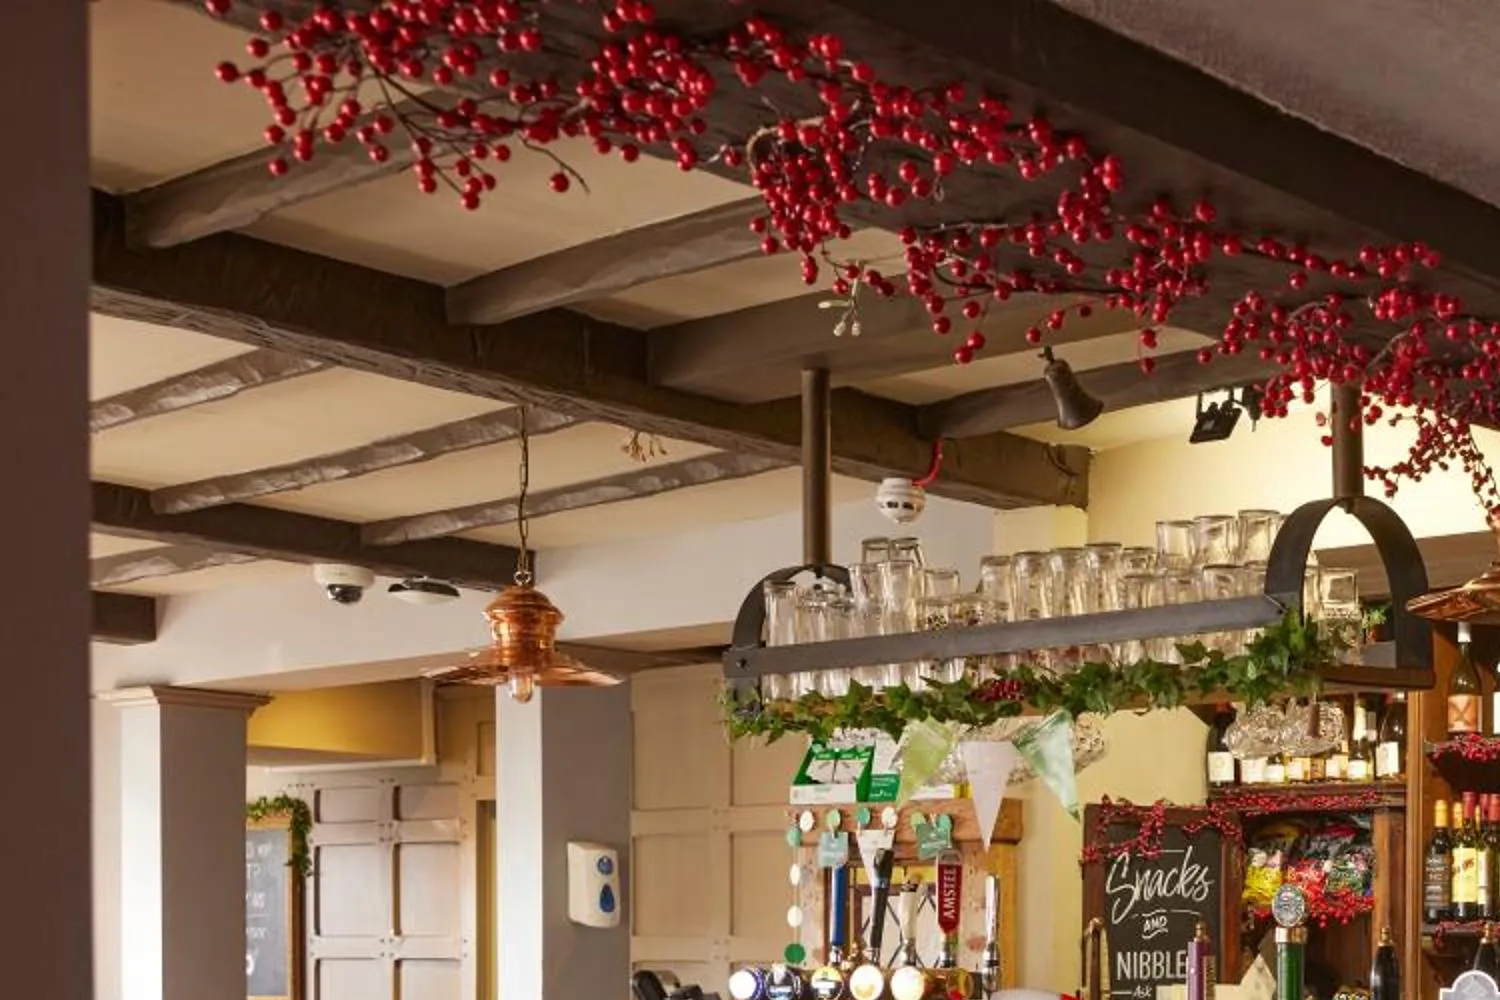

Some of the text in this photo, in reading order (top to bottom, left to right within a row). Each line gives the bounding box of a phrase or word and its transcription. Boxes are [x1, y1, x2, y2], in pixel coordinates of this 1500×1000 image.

[943, 867, 957, 919] AMSTEL
[1105, 845, 1215, 925] Snacks
[1143, 915, 1169, 933] AND
[1117, 950, 1188, 981] NIBBLE
